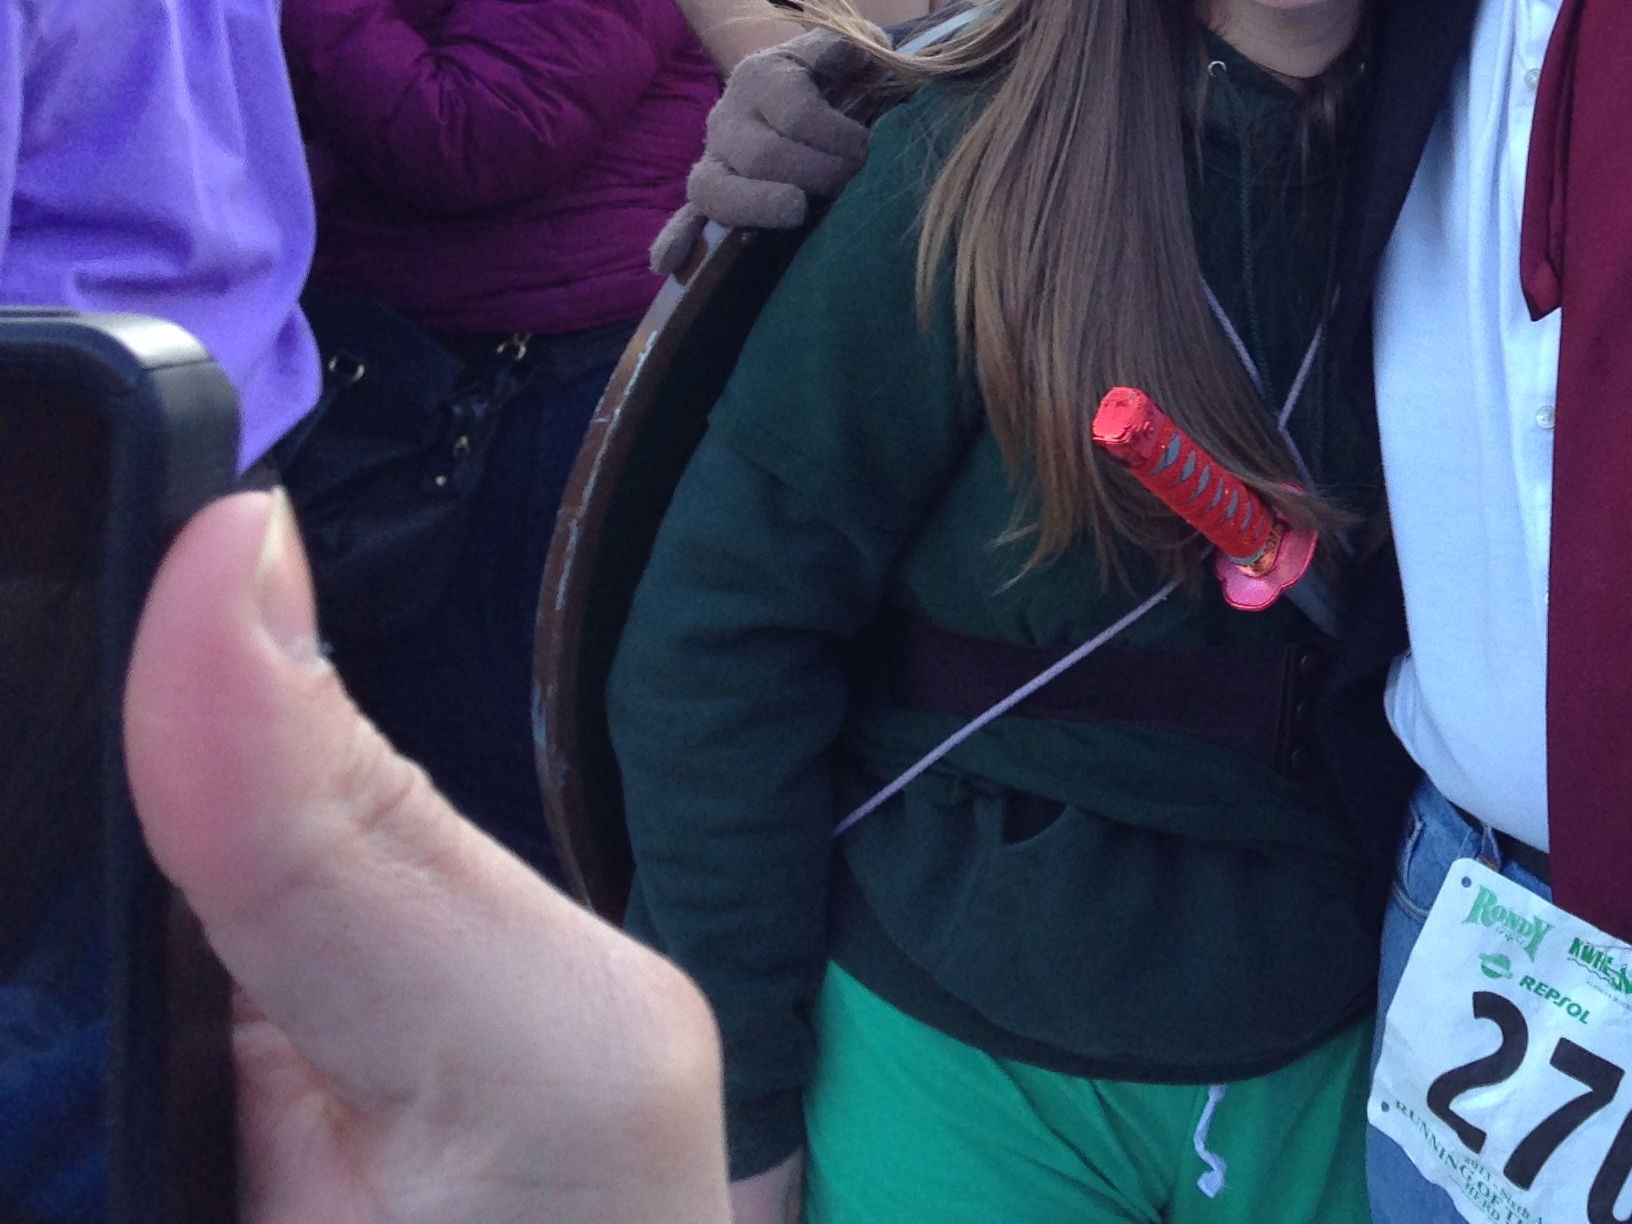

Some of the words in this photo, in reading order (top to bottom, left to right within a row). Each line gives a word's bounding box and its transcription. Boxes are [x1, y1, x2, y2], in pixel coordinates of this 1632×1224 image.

[1519, 974, 1592, 1025] REPSOL
[1394, 1100, 1472, 1183] RUNNING
[1477, 1180, 1504, 1207] OF
